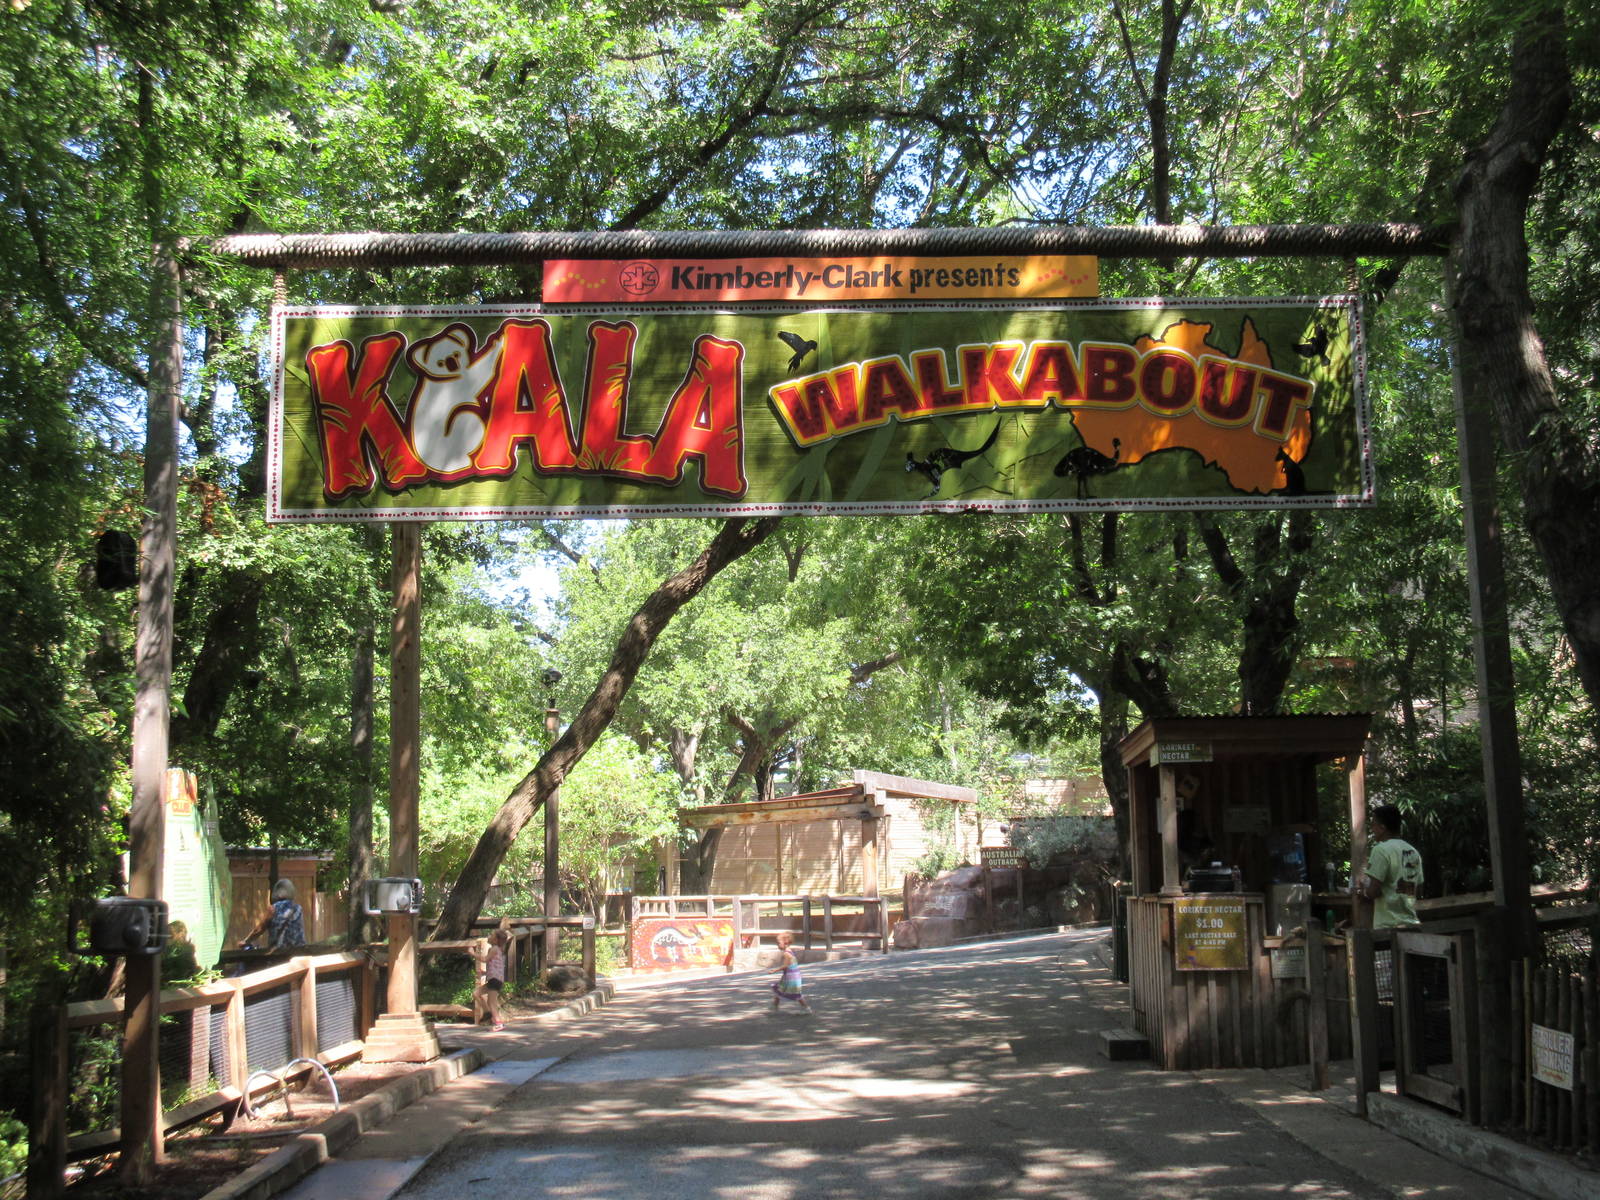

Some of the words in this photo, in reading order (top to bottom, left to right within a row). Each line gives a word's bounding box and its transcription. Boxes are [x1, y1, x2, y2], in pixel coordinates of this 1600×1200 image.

[671, 264, 904, 296] Kimberly-Clark
[909, 262, 1021, 293] presents
[769, 340, 1316, 448] WALKABOUT
[982, 850, 1024, 858] AUSTRALIAN
[988, 858, 1019, 866] OUTBACK
[1215, 905, 1243, 913] NECTAR
[1196, 918, 1224, 929] $1.00
